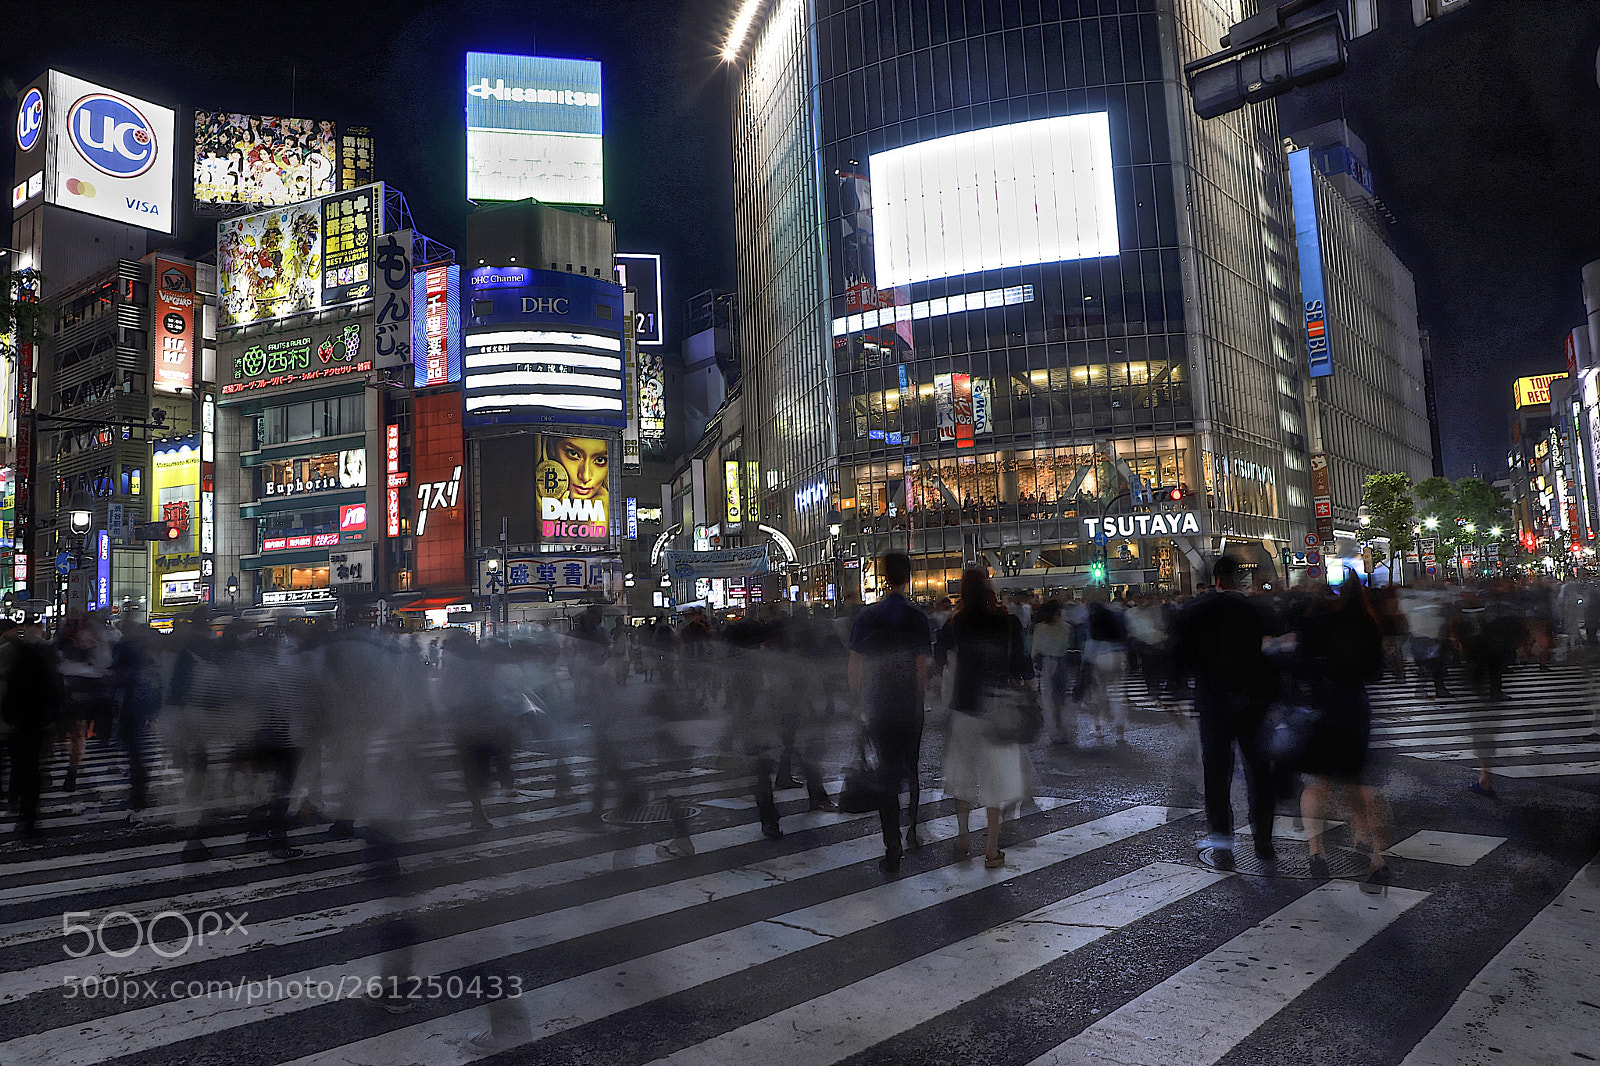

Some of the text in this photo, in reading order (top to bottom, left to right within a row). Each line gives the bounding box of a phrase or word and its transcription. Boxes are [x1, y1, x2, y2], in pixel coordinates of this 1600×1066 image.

[468, 78, 600, 106] Hisamitsu
[20, 101, 42, 137] UC
[80, 109, 148, 161] UC
[126, 197, 159, 215] VISA
[326, 256, 342, 267] BEST
[343, 250, 369, 264] ALBUM
[471, 273, 524, 285] DHC Channel
[158, 289, 192, 308] VANGUARD
[376, 235, 410, 362] もんじゃ
[521, 297, 569, 315] DHC
[426, 271, 443, 378] 三千里薬品
[1305, 299, 1328, 367] SEIBU
[290, 337, 311, 347] PARLOR
[268, 346, 311, 374] 西村
[1549, 427, 1561, 468] KARAOKE
[266, 476, 336, 495] Euphoria
[416, 465, 462, 536] クスリ
[542, 497, 606, 521] DMM
[113, 505, 121, 535] 渋谷駅前
[163, 501, 190, 531] 薬
[341, 507, 366, 528] JTB
[542, 521, 606, 537] Bitcoin
[1083, 512, 1200, 539] TSUTAYA
[485, 563, 603, 593] 大盛堂書店
